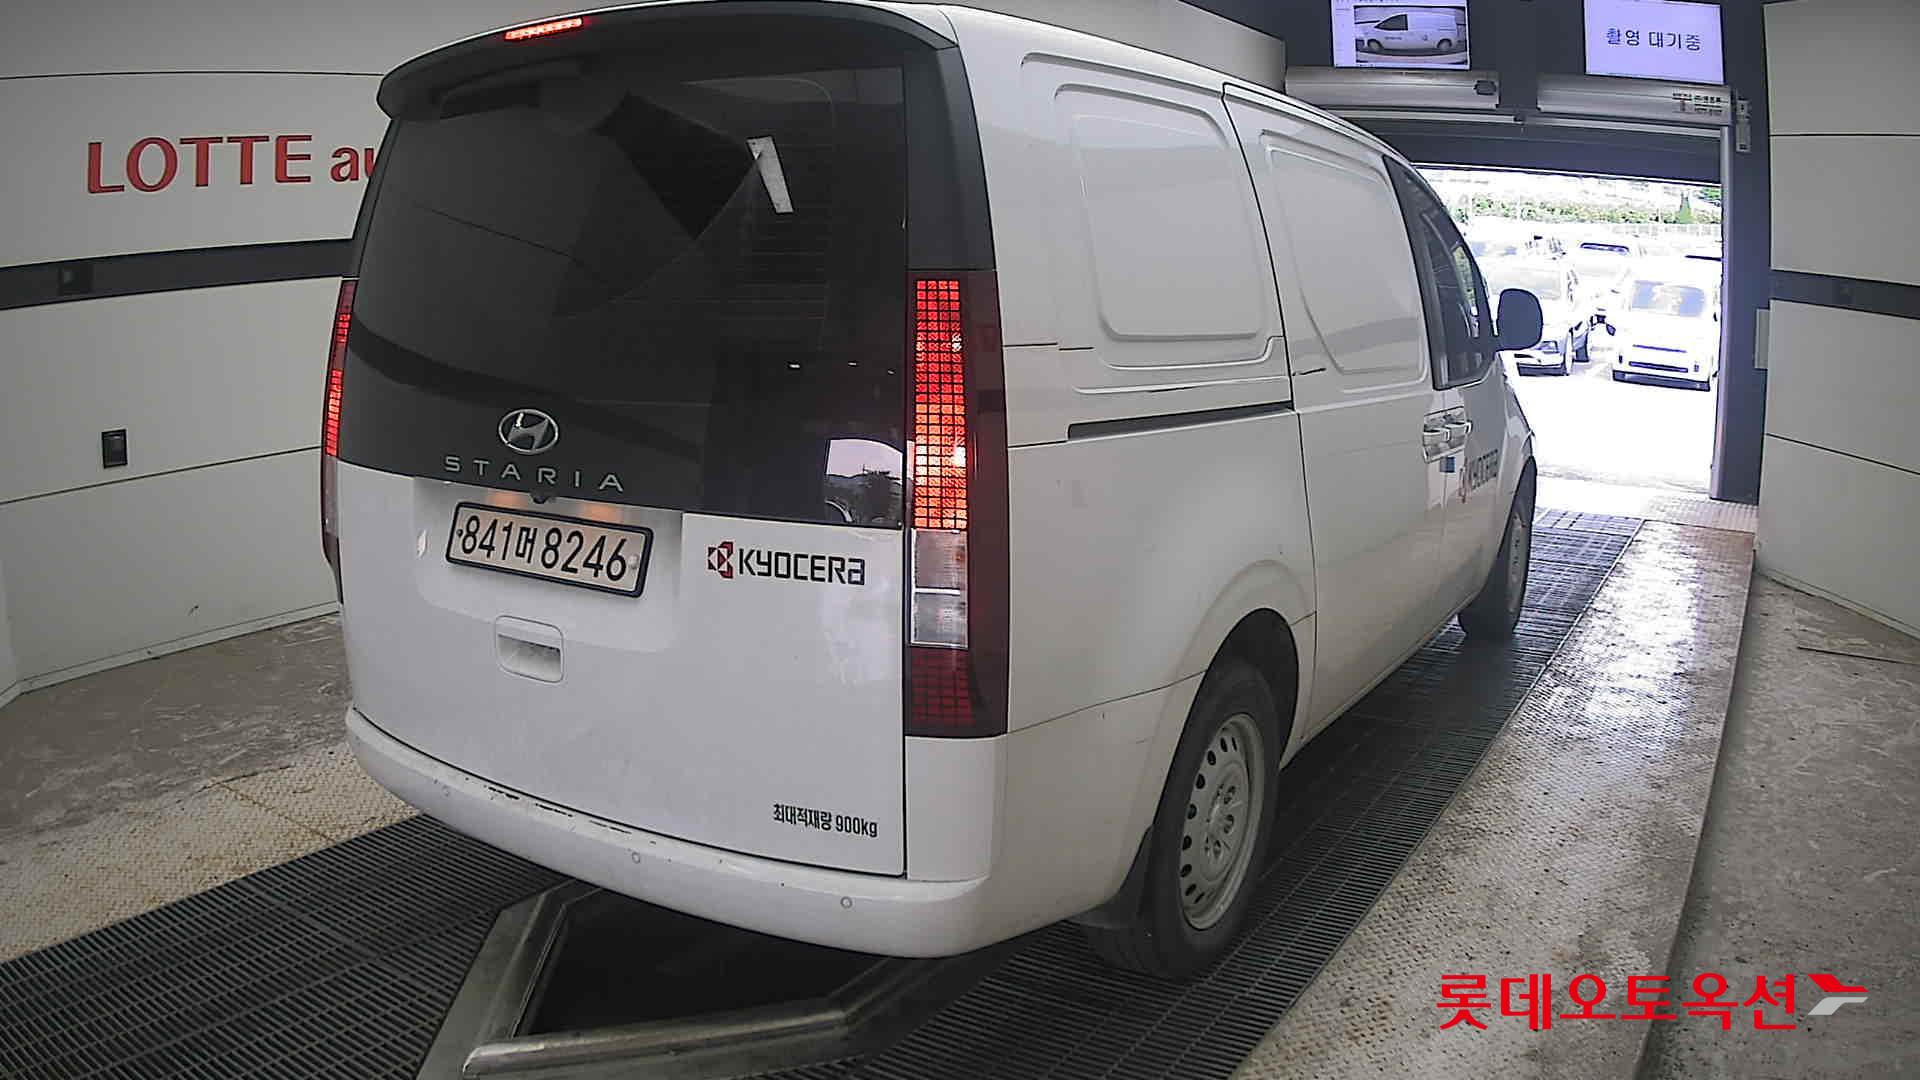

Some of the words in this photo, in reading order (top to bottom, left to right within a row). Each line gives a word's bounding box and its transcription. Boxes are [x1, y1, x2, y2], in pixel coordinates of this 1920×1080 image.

[1648, 31, 1701, 51] 대기중
[87, 134, 313, 194] LOTTE
[444, 456, 624, 492] STARIA
[773, 803, 832, 831] 최대적재량
[835, 814, 877, 838] 900kg
